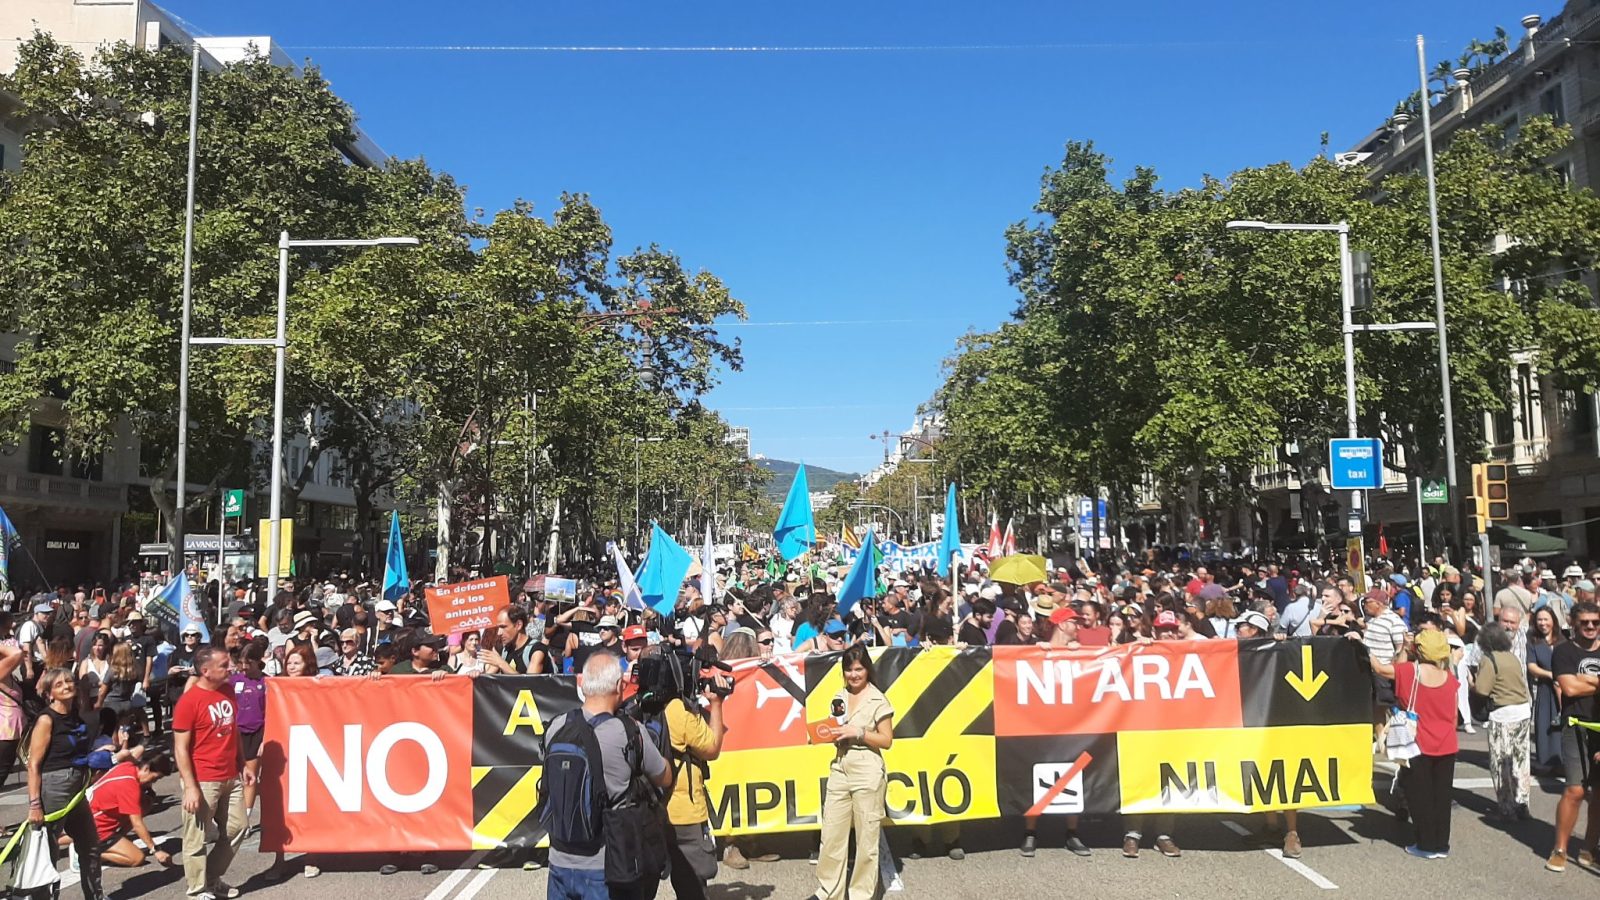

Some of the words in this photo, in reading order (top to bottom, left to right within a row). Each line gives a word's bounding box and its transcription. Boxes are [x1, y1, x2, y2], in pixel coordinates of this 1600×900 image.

[1347, 469, 1367, 479] taxi
[436, 588, 451, 596] En
[453, 581, 496, 593] defensa
[452, 597, 465, 605] de
[468, 595, 484, 603] los
[445, 605, 494, 619] animales
[1015, 659, 1074, 705] NI
[1091, 653, 1216, 703] ARA
[502, 689, 545, 736] A
[287, 721, 448, 814] NO
[1159, 760, 1218, 806] NI
[1240, 757, 1341, 805] MAI
